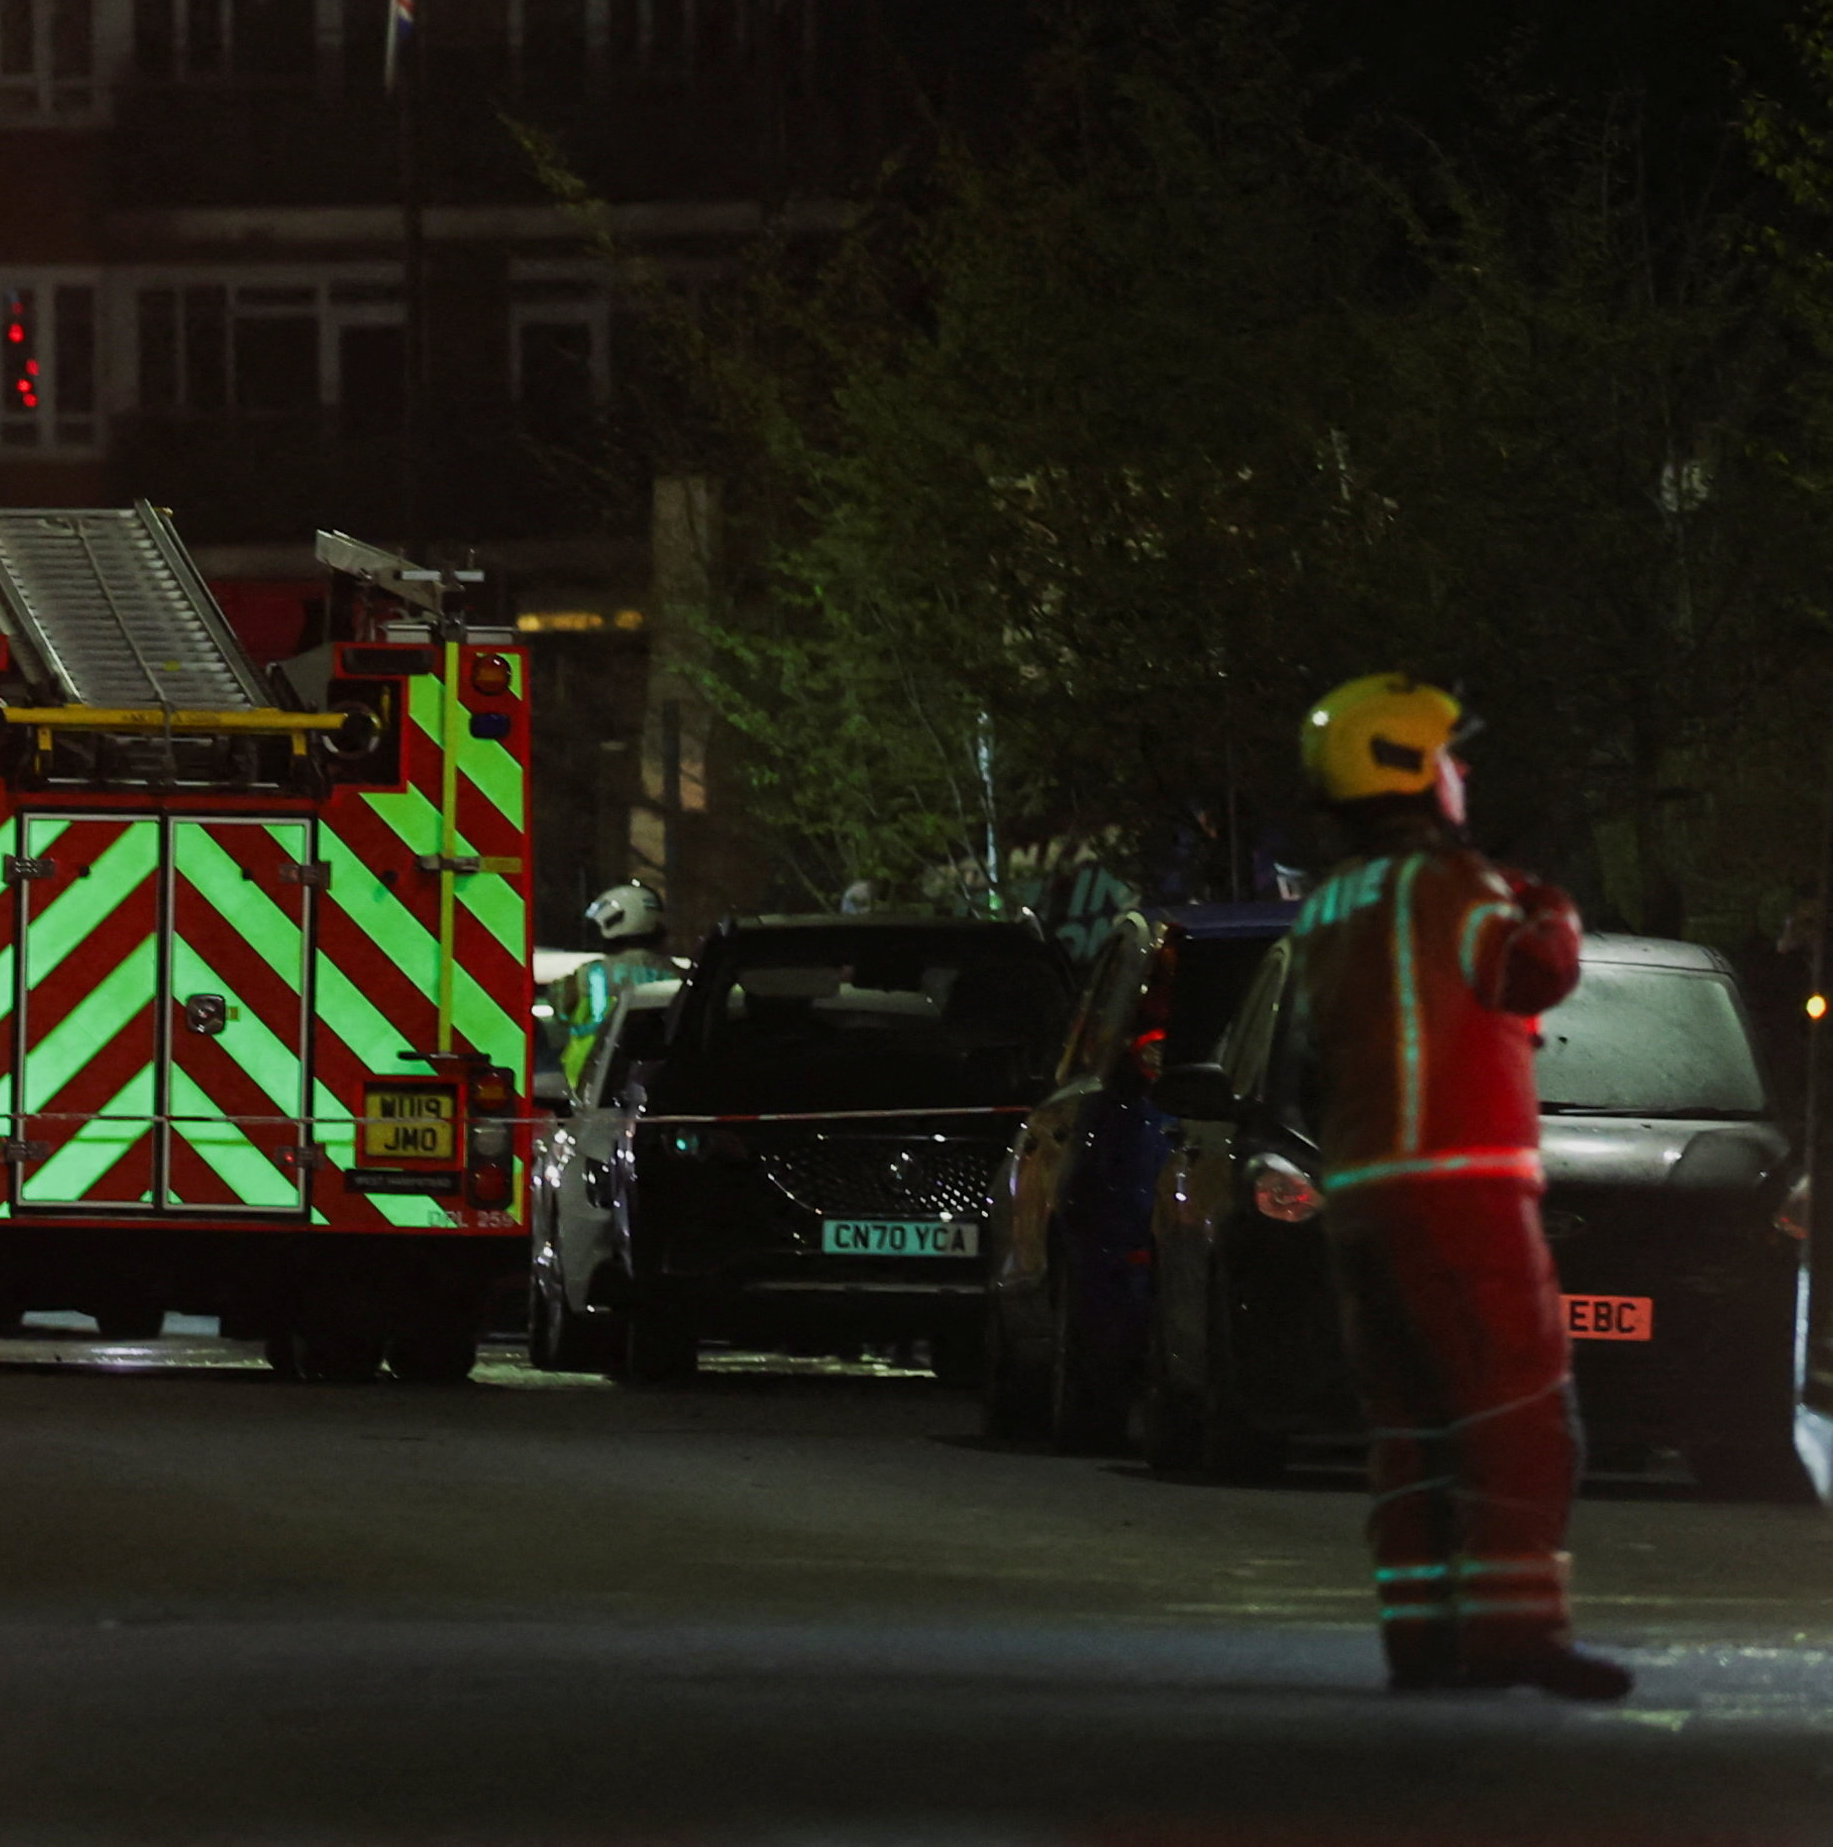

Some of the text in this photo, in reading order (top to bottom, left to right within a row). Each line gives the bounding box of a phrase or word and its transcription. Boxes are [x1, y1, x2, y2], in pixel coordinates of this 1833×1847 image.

[383, 1127, 437, 1151] JMO
[834, 1224, 967, 1252] CN70 YCA
[1569, 1300, 1636, 1334] EBC
